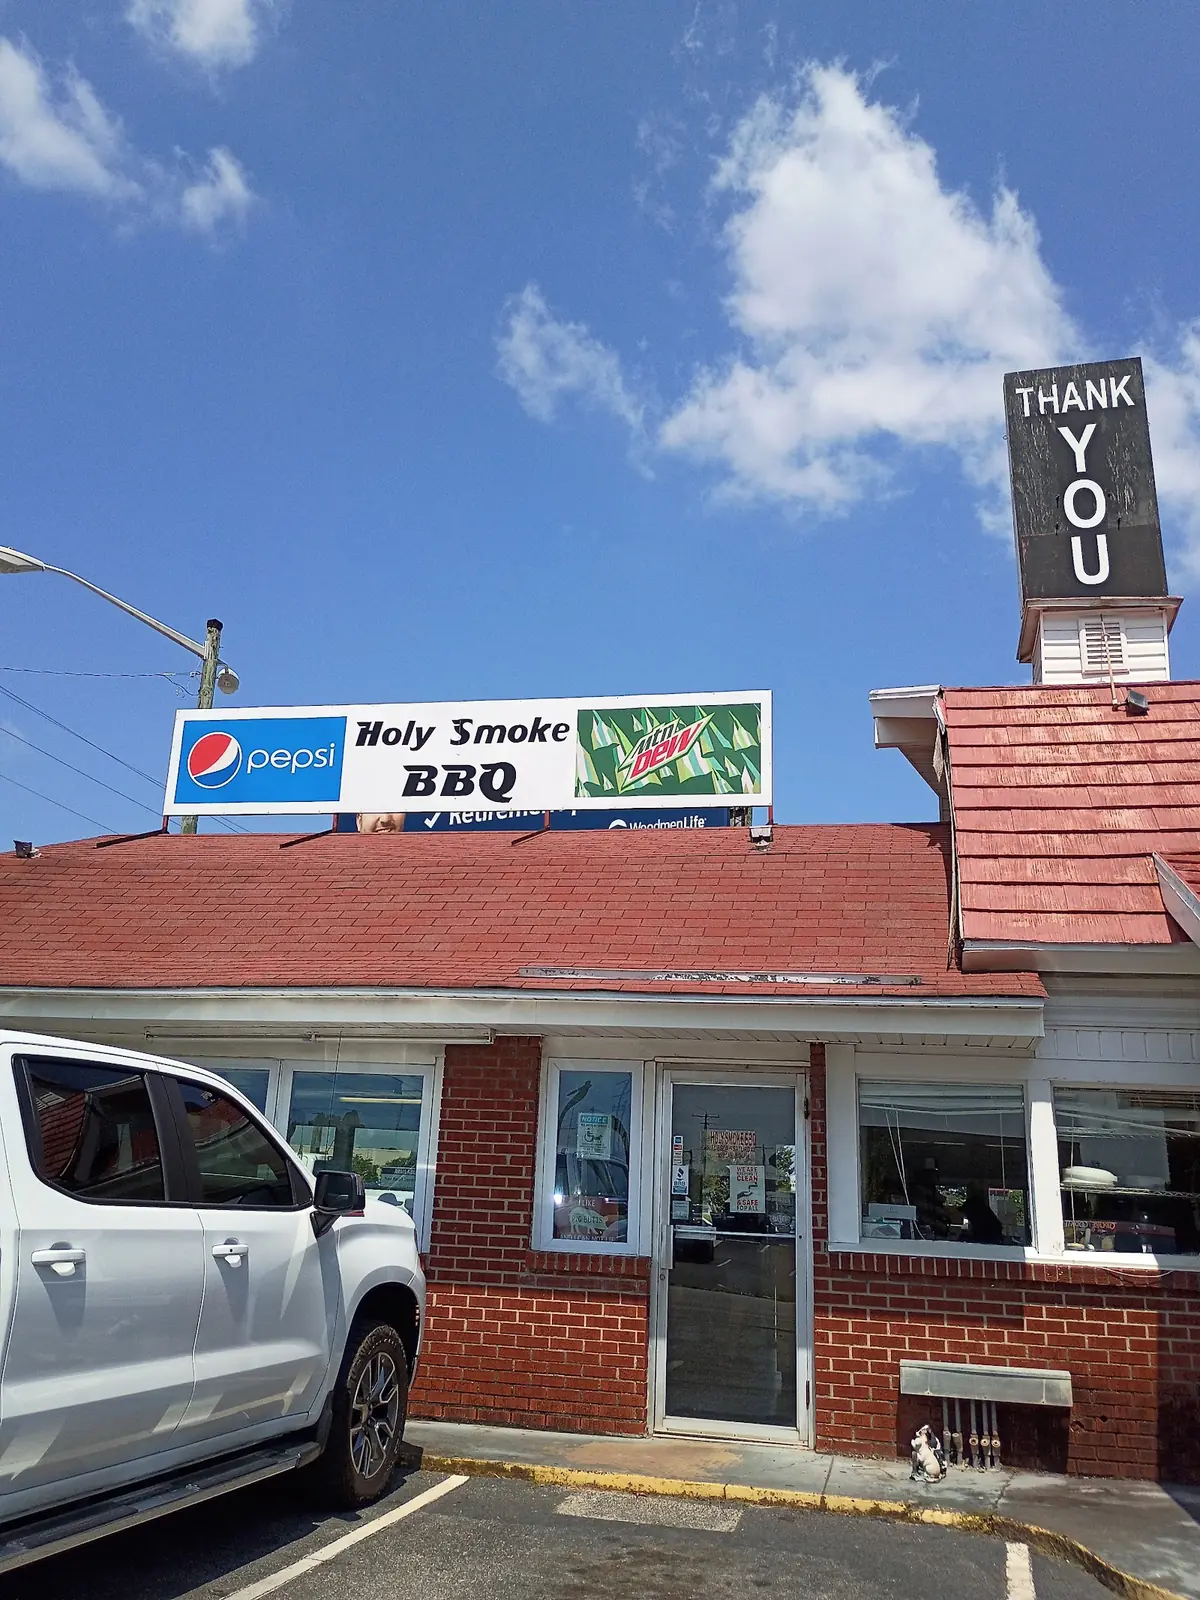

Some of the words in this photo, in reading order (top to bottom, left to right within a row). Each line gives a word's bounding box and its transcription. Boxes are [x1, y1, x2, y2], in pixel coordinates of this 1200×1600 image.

[1015, 374, 1135, 417] THANK
[1058, 423, 1110, 585] YOU
[355, 720, 436, 751] Holy
[450, 717, 570, 745] Smoke
[246, 743, 335, 774] pepsi
[401, 761, 517, 803] BBQ
[583, 1199, 596, 1207] LIKE
